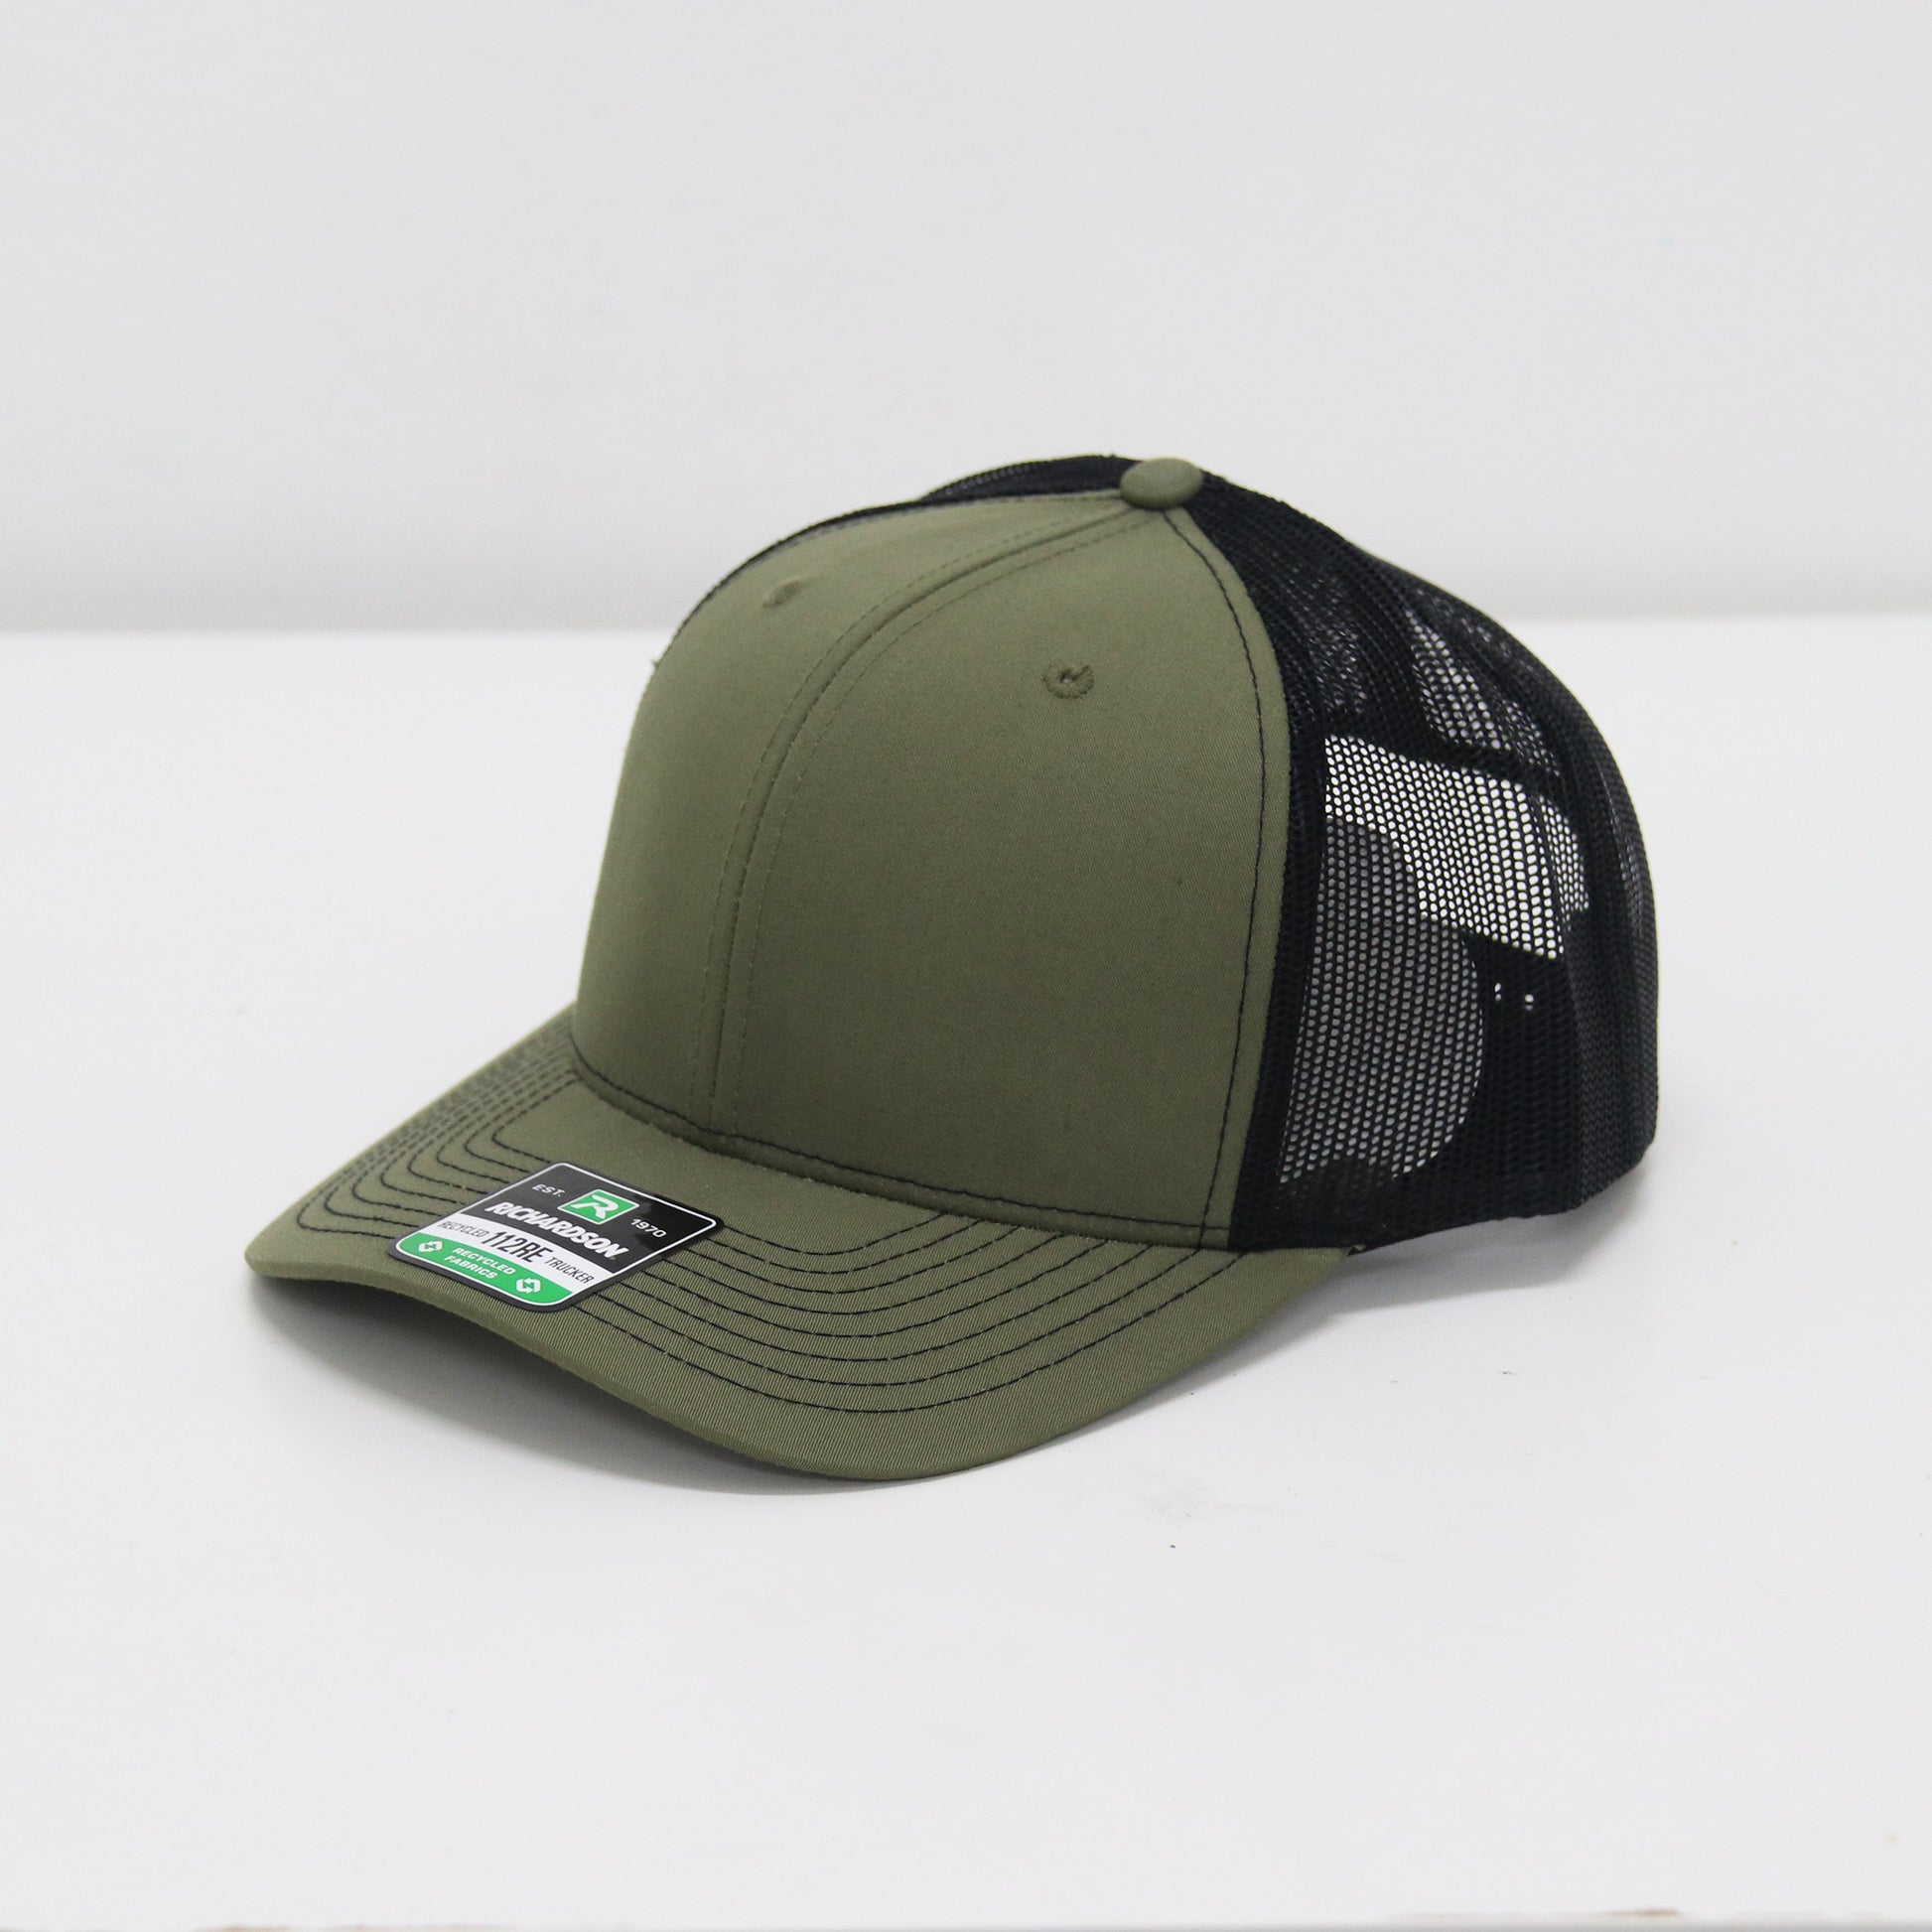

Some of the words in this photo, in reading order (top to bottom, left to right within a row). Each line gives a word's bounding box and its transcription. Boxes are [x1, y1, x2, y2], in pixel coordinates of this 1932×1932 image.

[484, 1201, 630, 1259] RICHARDSON
[532, 1183, 565, 1197] EST.
[630, 1218, 667, 1239] 1970
[438, 1220, 486, 1238] RECYCLED
[481, 1231, 553, 1264] 112RE
[545, 1256, 595, 1285] TRUCKER
[444, 1255, 498, 1280] FABRICS
[453, 1247, 516, 1276] RECYCLED
